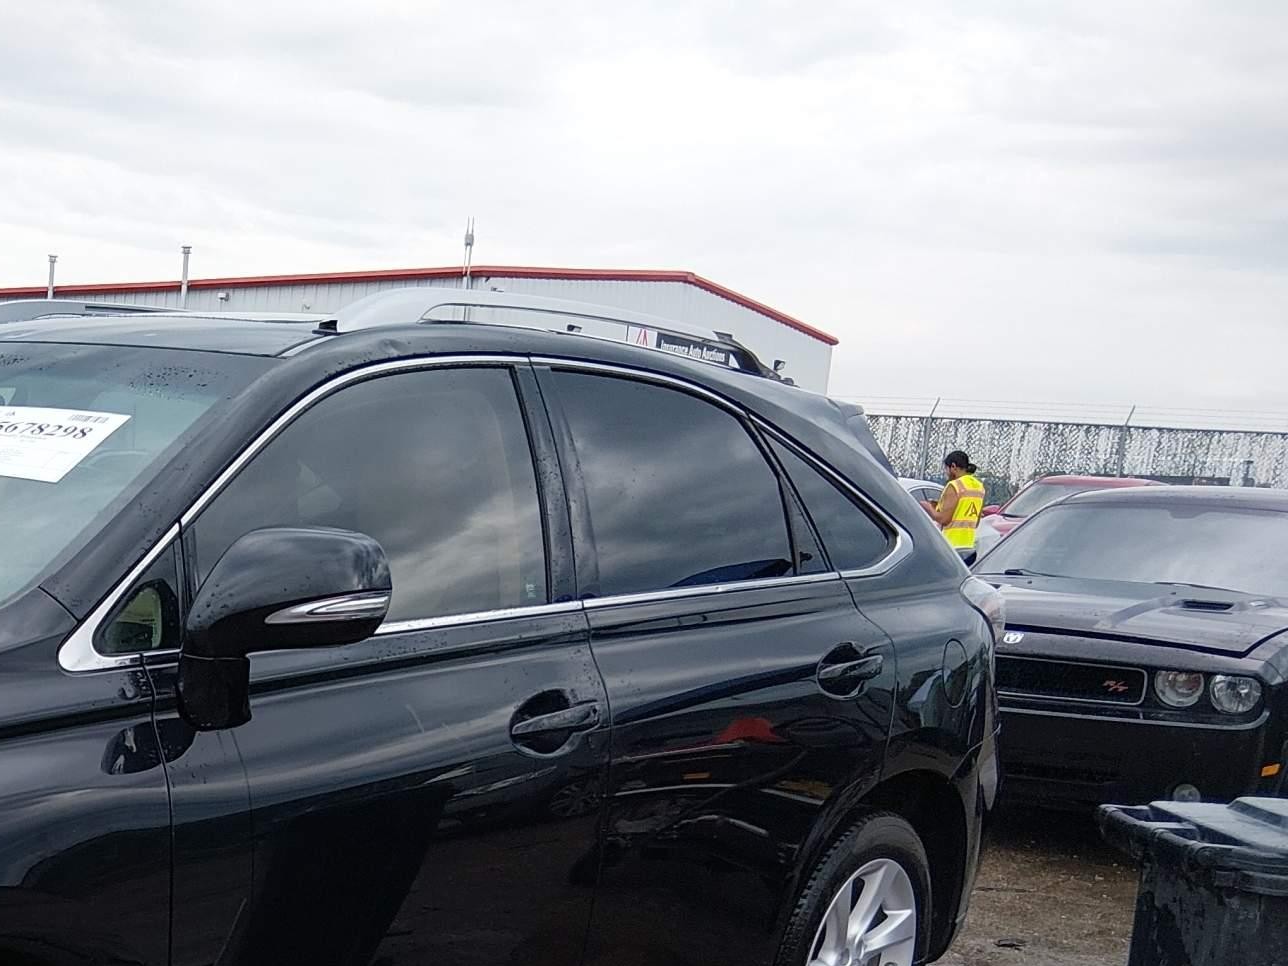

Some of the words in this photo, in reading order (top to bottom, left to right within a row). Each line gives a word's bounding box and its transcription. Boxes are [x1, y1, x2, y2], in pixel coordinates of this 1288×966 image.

[661, 340, 688, 354] Insurance
[689, 344, 701, 358] Auto
[702, 346, 725, 362] Auctions
